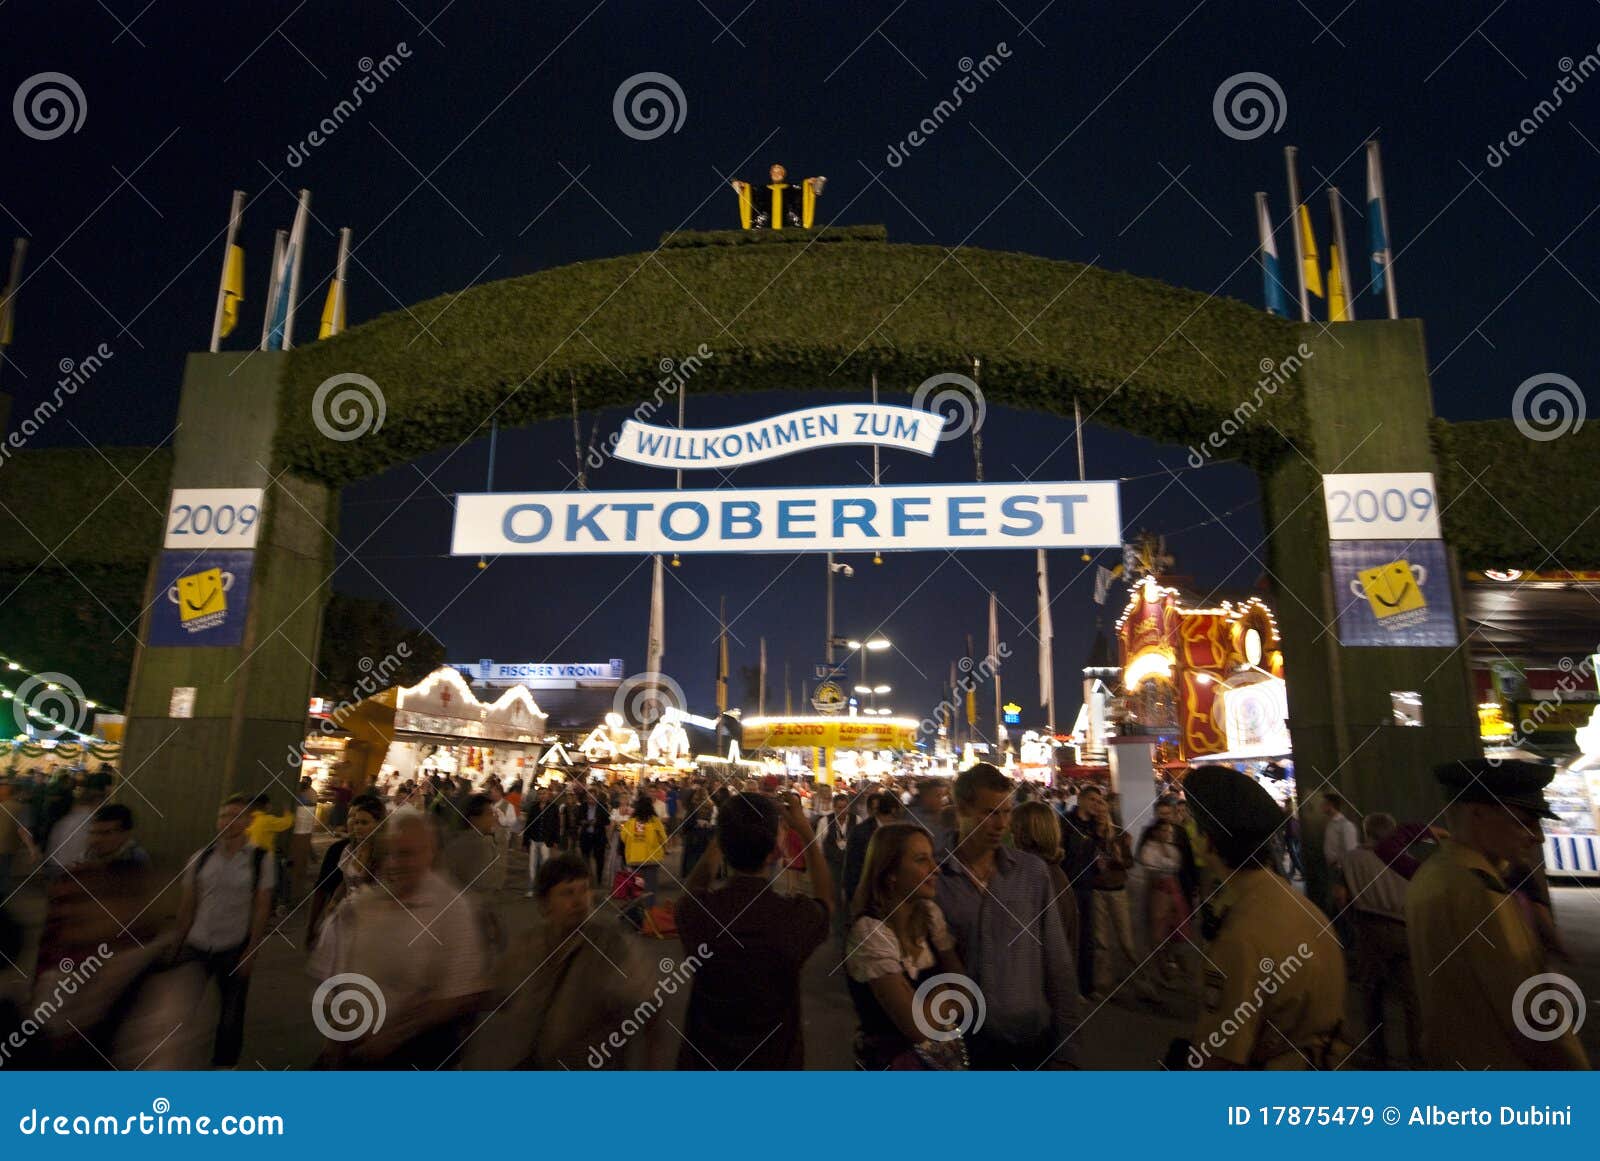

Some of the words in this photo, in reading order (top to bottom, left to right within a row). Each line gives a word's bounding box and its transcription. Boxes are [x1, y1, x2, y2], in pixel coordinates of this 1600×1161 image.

[636, 413, 839, 460] WILLKOMMEN
[854, 412, 920, 441] ZUM
[168, 504, 259, 535] 2009
[501, 494, 1089, 543] OKTOBERFEST
[1328, 487, 1433, 522] 2009
[500, 666, 553, 677] FISCHER
[558, 666, 601, 676] VRONI
[786, 725, 825, 736] LOTTO
